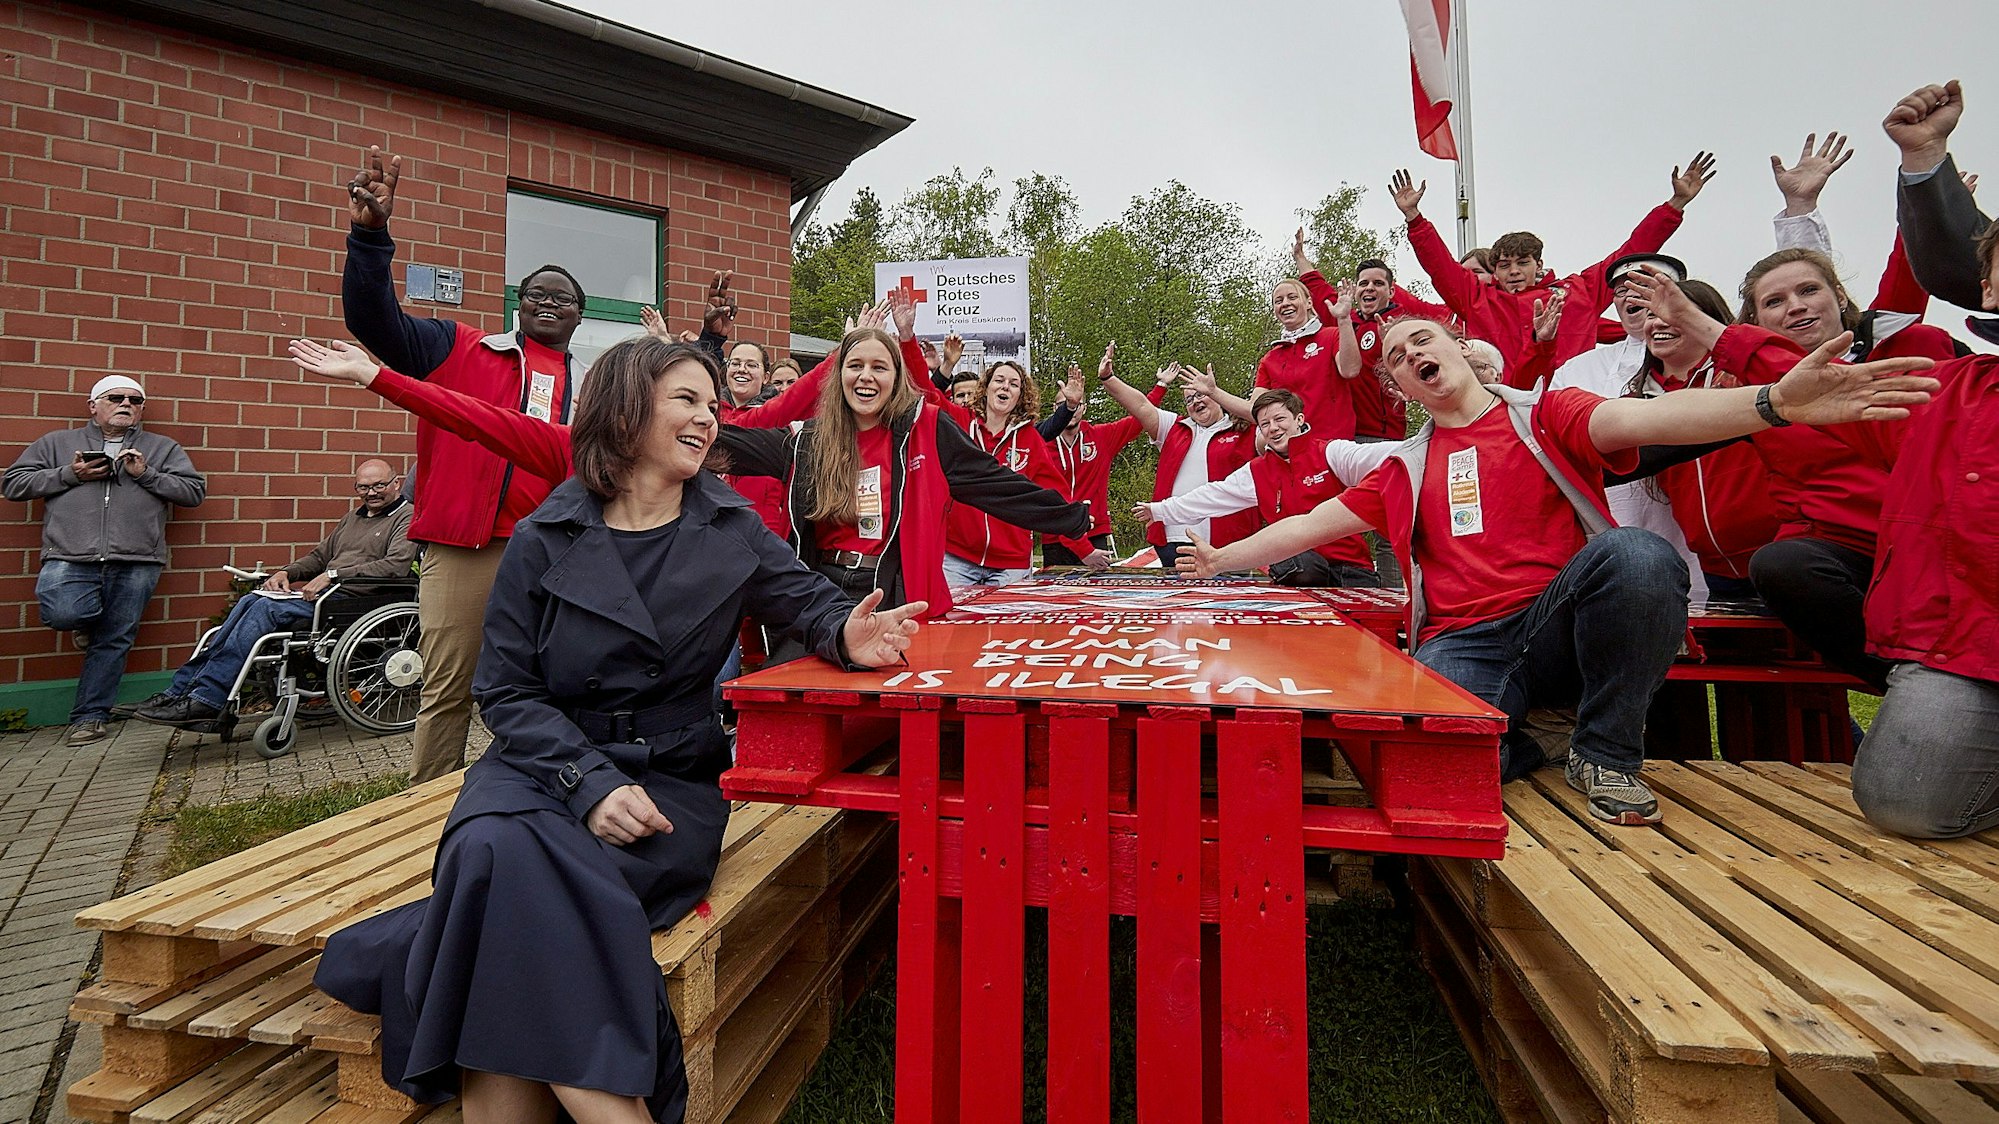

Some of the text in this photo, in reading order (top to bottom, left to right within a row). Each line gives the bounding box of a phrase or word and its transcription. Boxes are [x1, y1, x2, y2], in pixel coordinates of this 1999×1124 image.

[936, 272, 1016, 286] Deutsches
[937, 289, 980, 301] Rotes
[937, 304, 980, 316] Kreuz
[972, 316, 1017, 324] Euskirchen
[1452, 455, 1475, 467] PEACE
[1068, 624, 1156, 636] NO
[981, 638, 1232, 651] HUMAN
[972, 651, 1203, 670] BEING
[882, 669, 1334, 696] IS ILLEGAL
